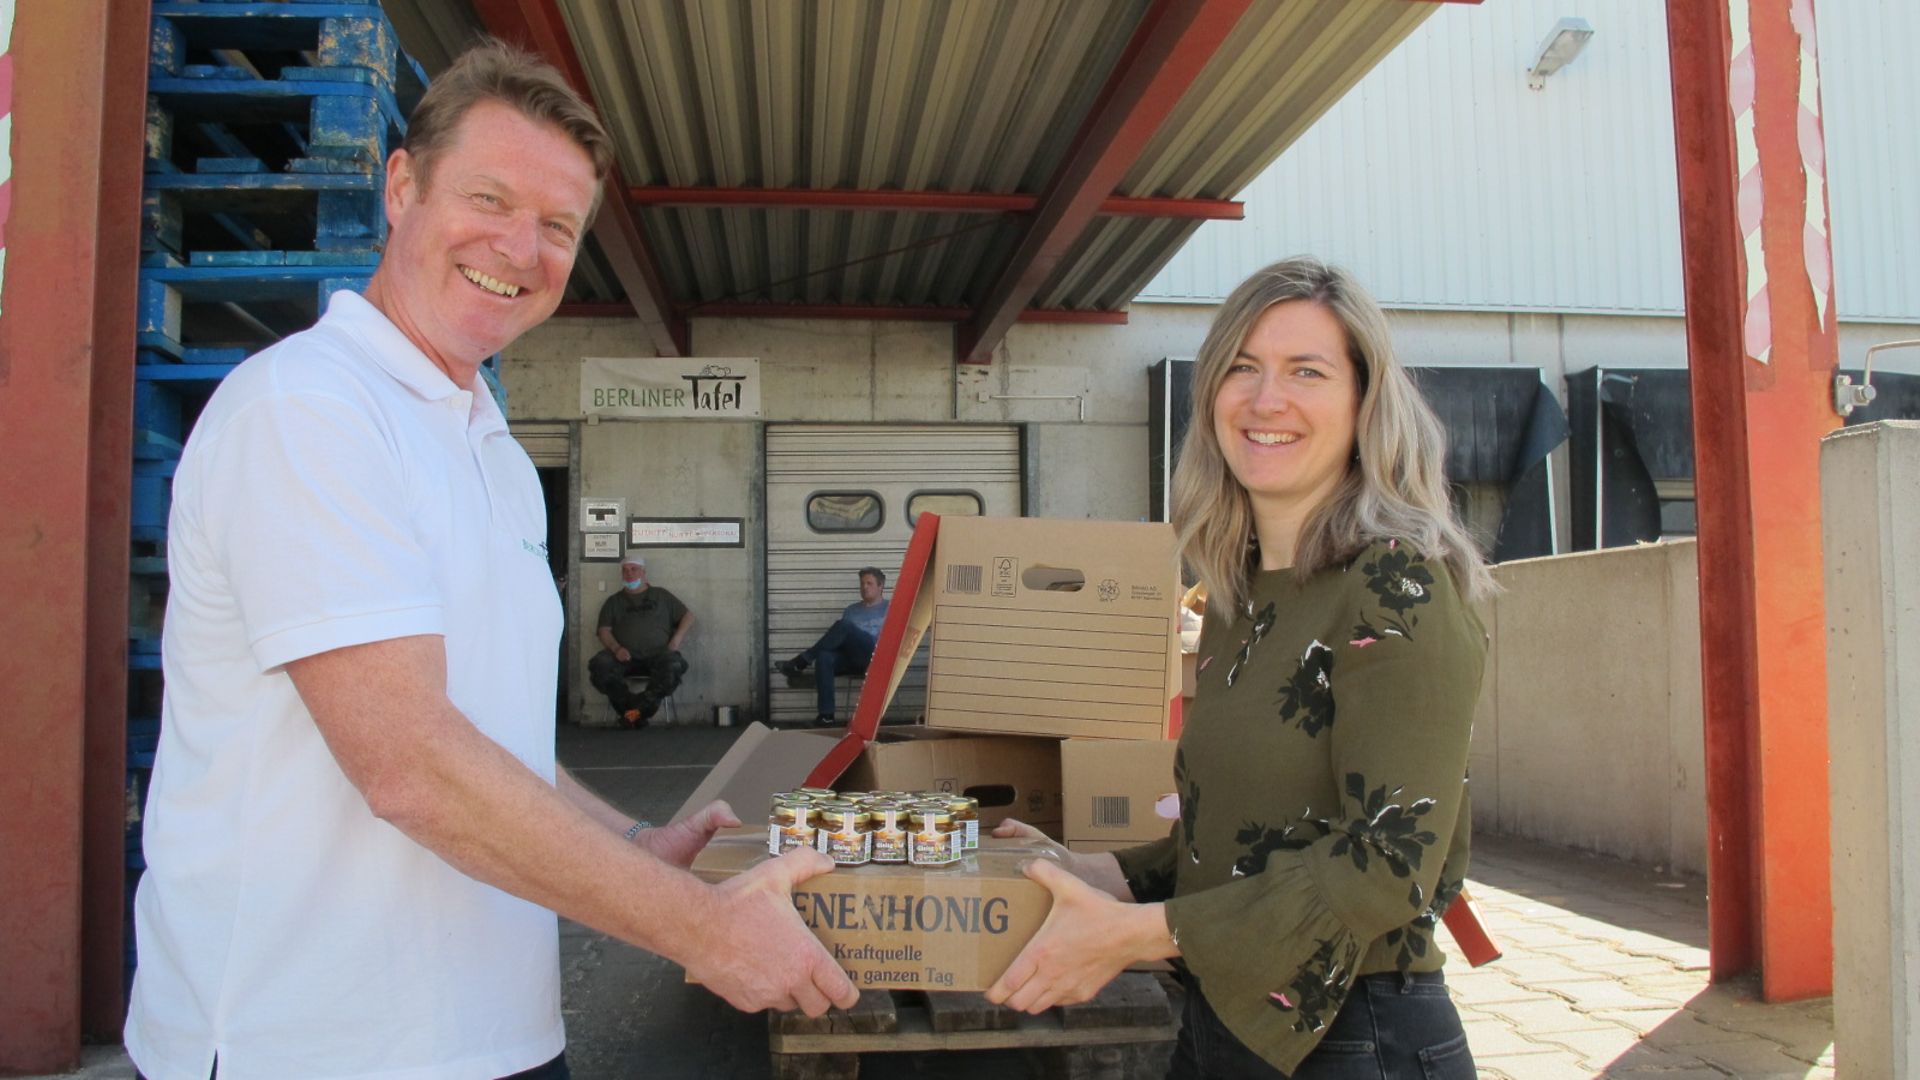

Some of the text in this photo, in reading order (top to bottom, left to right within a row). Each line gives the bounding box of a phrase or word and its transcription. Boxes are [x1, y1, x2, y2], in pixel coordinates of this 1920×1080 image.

[594, 374, 747, 411] BERLINER Tafel
[834, 942, 922, 963] Kraftquelle
[863, 969, 920, 985] ganzen
[925, 967, 954, 986] Tag
